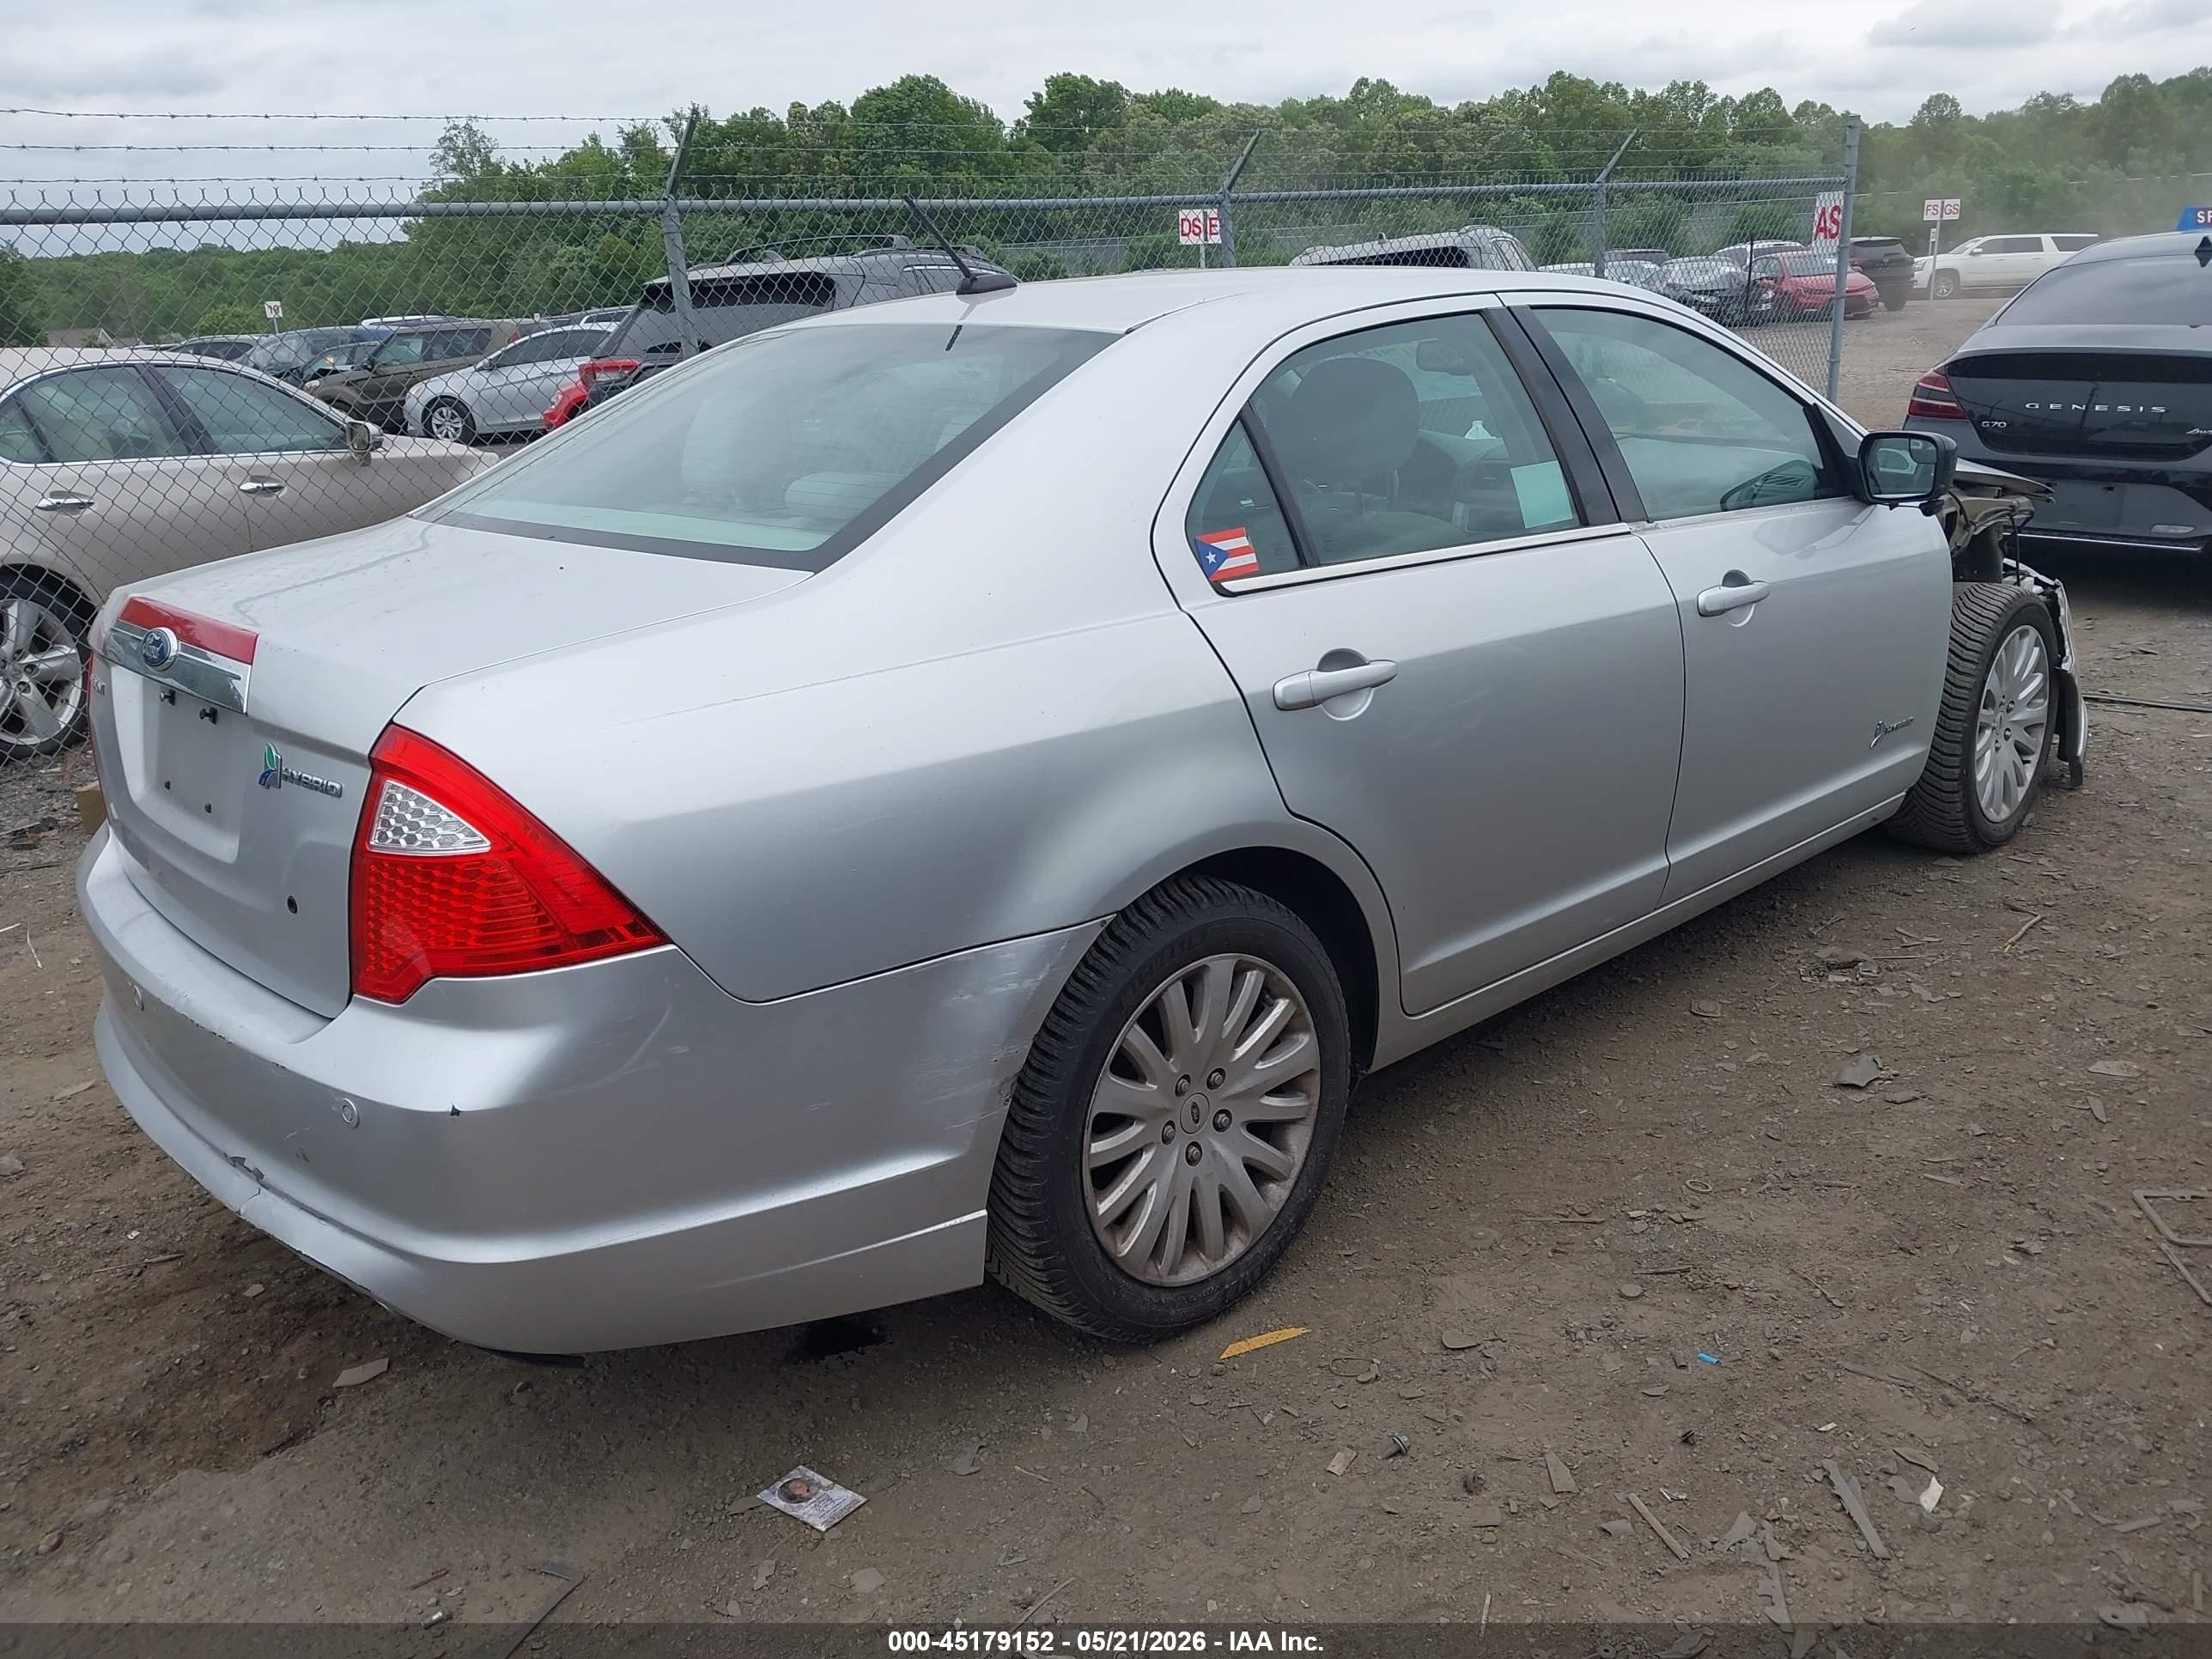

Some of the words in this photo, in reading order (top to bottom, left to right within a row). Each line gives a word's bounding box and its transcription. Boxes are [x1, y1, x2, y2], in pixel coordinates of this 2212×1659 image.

[1926, 204, 1939, 216] FS
[1944, 204, 1959, 215] GS
[1181, 217, 1201, 236] DS
[1814, 205, 1841, 241] AS
[2025, 402, 2166, 413] GENESIS
[282, 766, 343, 798] HYBRID
